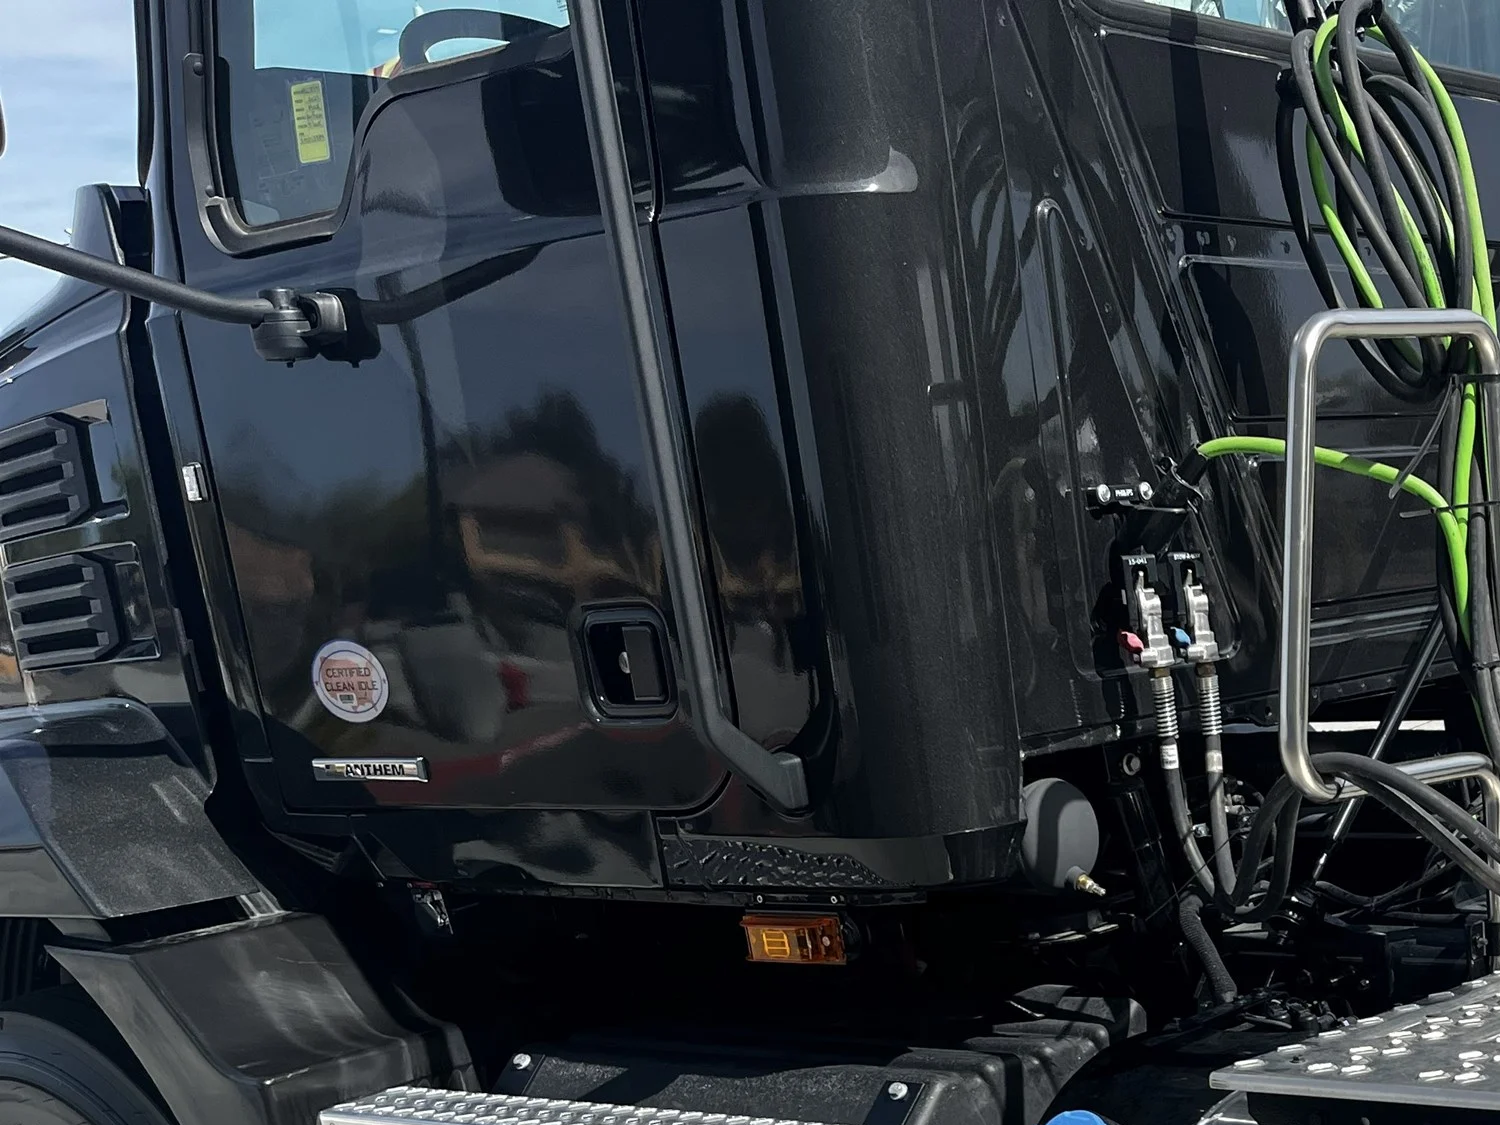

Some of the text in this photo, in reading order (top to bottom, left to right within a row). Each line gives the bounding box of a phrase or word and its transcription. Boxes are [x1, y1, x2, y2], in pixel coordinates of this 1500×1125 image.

[325, 667, 371, 679] CERTIFIED
[324, 680, 379, 692] CLEAN IDLE
[345, 764, 405, 777] ANTHEM
